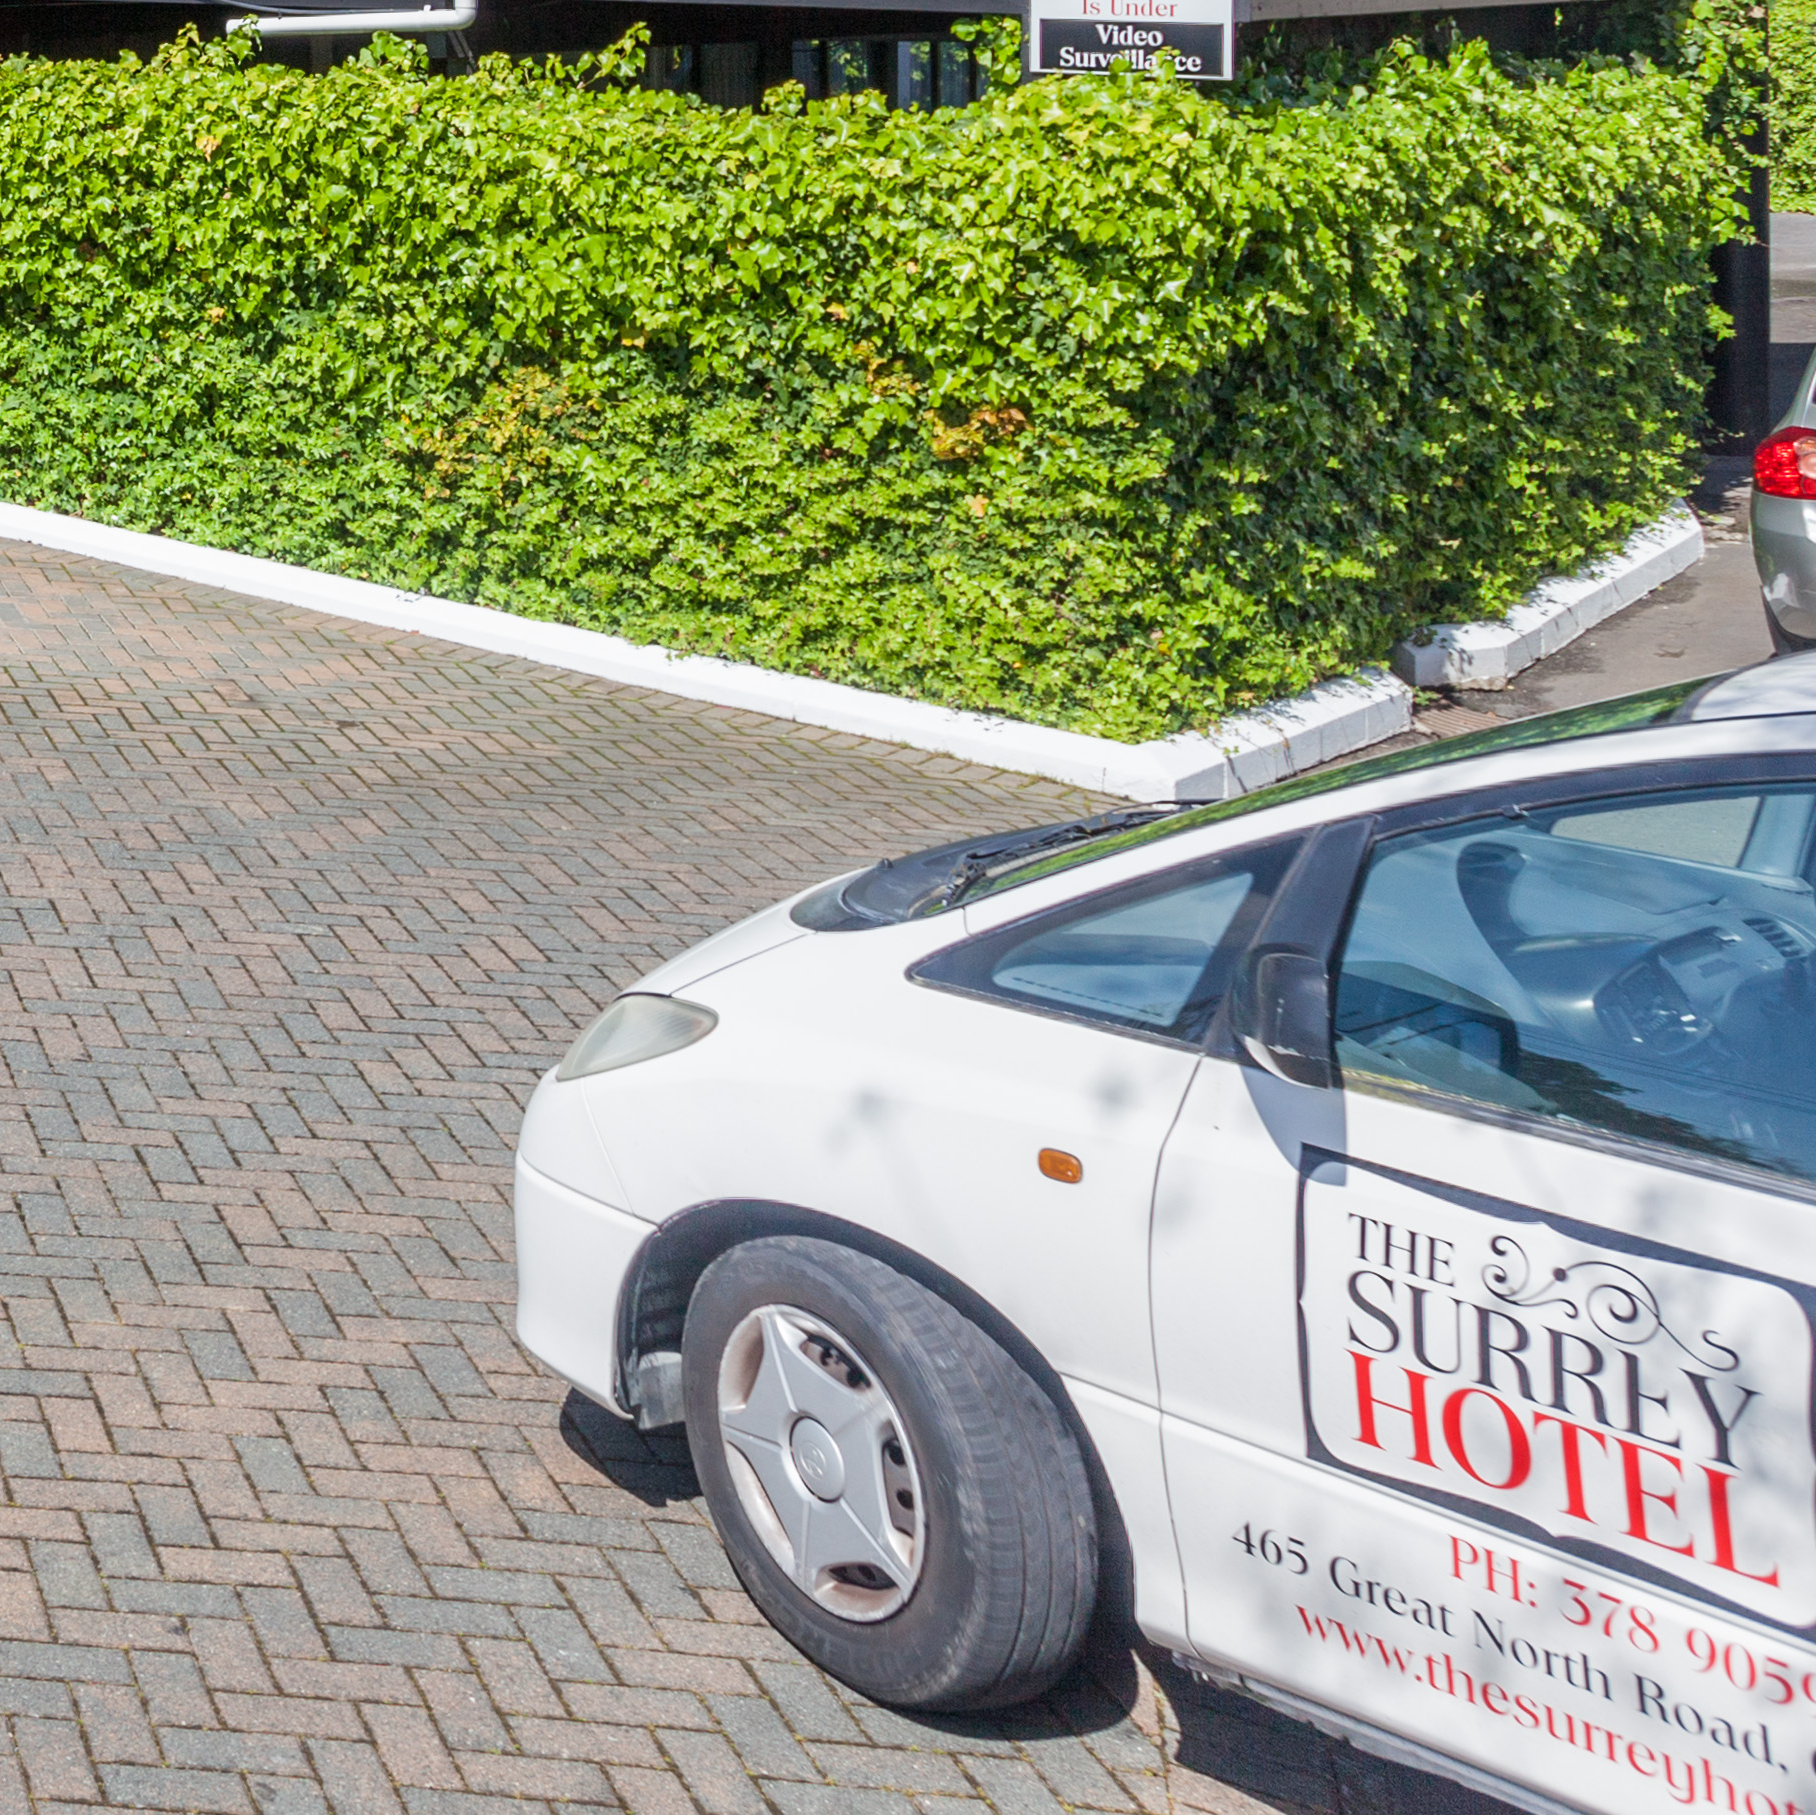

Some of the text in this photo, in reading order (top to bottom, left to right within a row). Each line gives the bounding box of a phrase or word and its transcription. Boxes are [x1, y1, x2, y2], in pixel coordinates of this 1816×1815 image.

[1095, 24, 1164, 46] Video
[1347, 1212, 1456, 1287] THE
[1347, 1270, 1764, 1471] SURREY
[1344, 1348, 1781, 1588] HOTEL
[1231, 1521, 1789, 1774] 465 Great North Road,
[1448, 1534, 1538, 1608] PH:
[1559, 1577, 1659, 1653] 378
